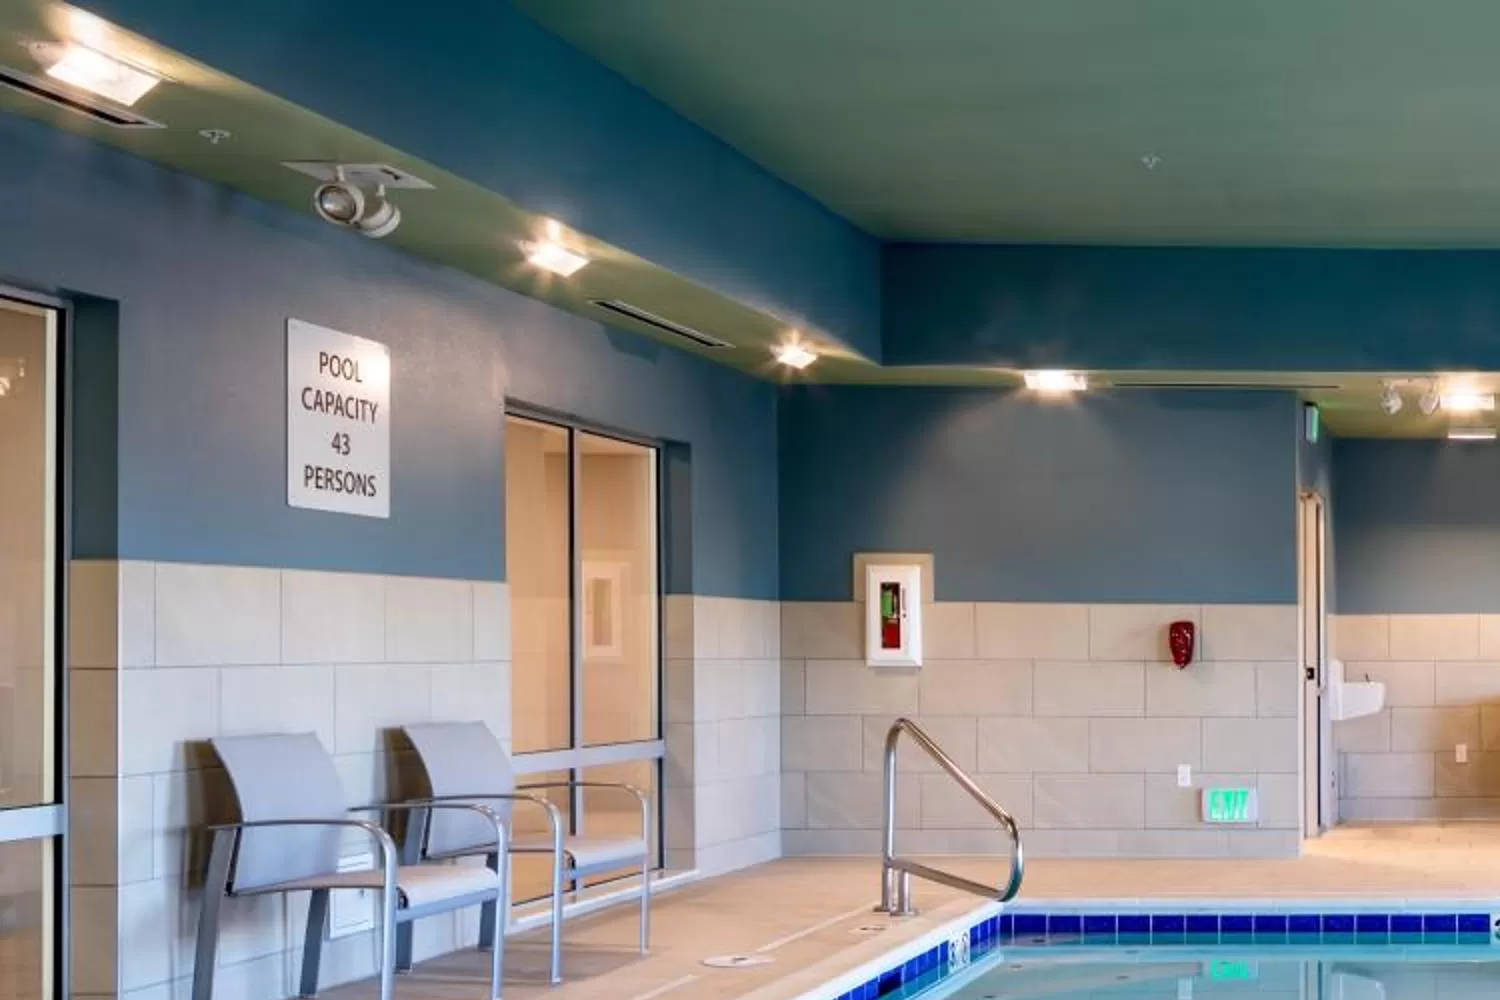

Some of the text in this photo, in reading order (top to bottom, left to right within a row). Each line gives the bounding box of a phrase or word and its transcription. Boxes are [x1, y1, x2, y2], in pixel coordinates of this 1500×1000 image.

[319, 352, 362, 383] POOL
[302, 387, 379, 425] CAPACITY
[331, 432, 351, 455] 43
[304, 465, 377, 497] PERSONS
